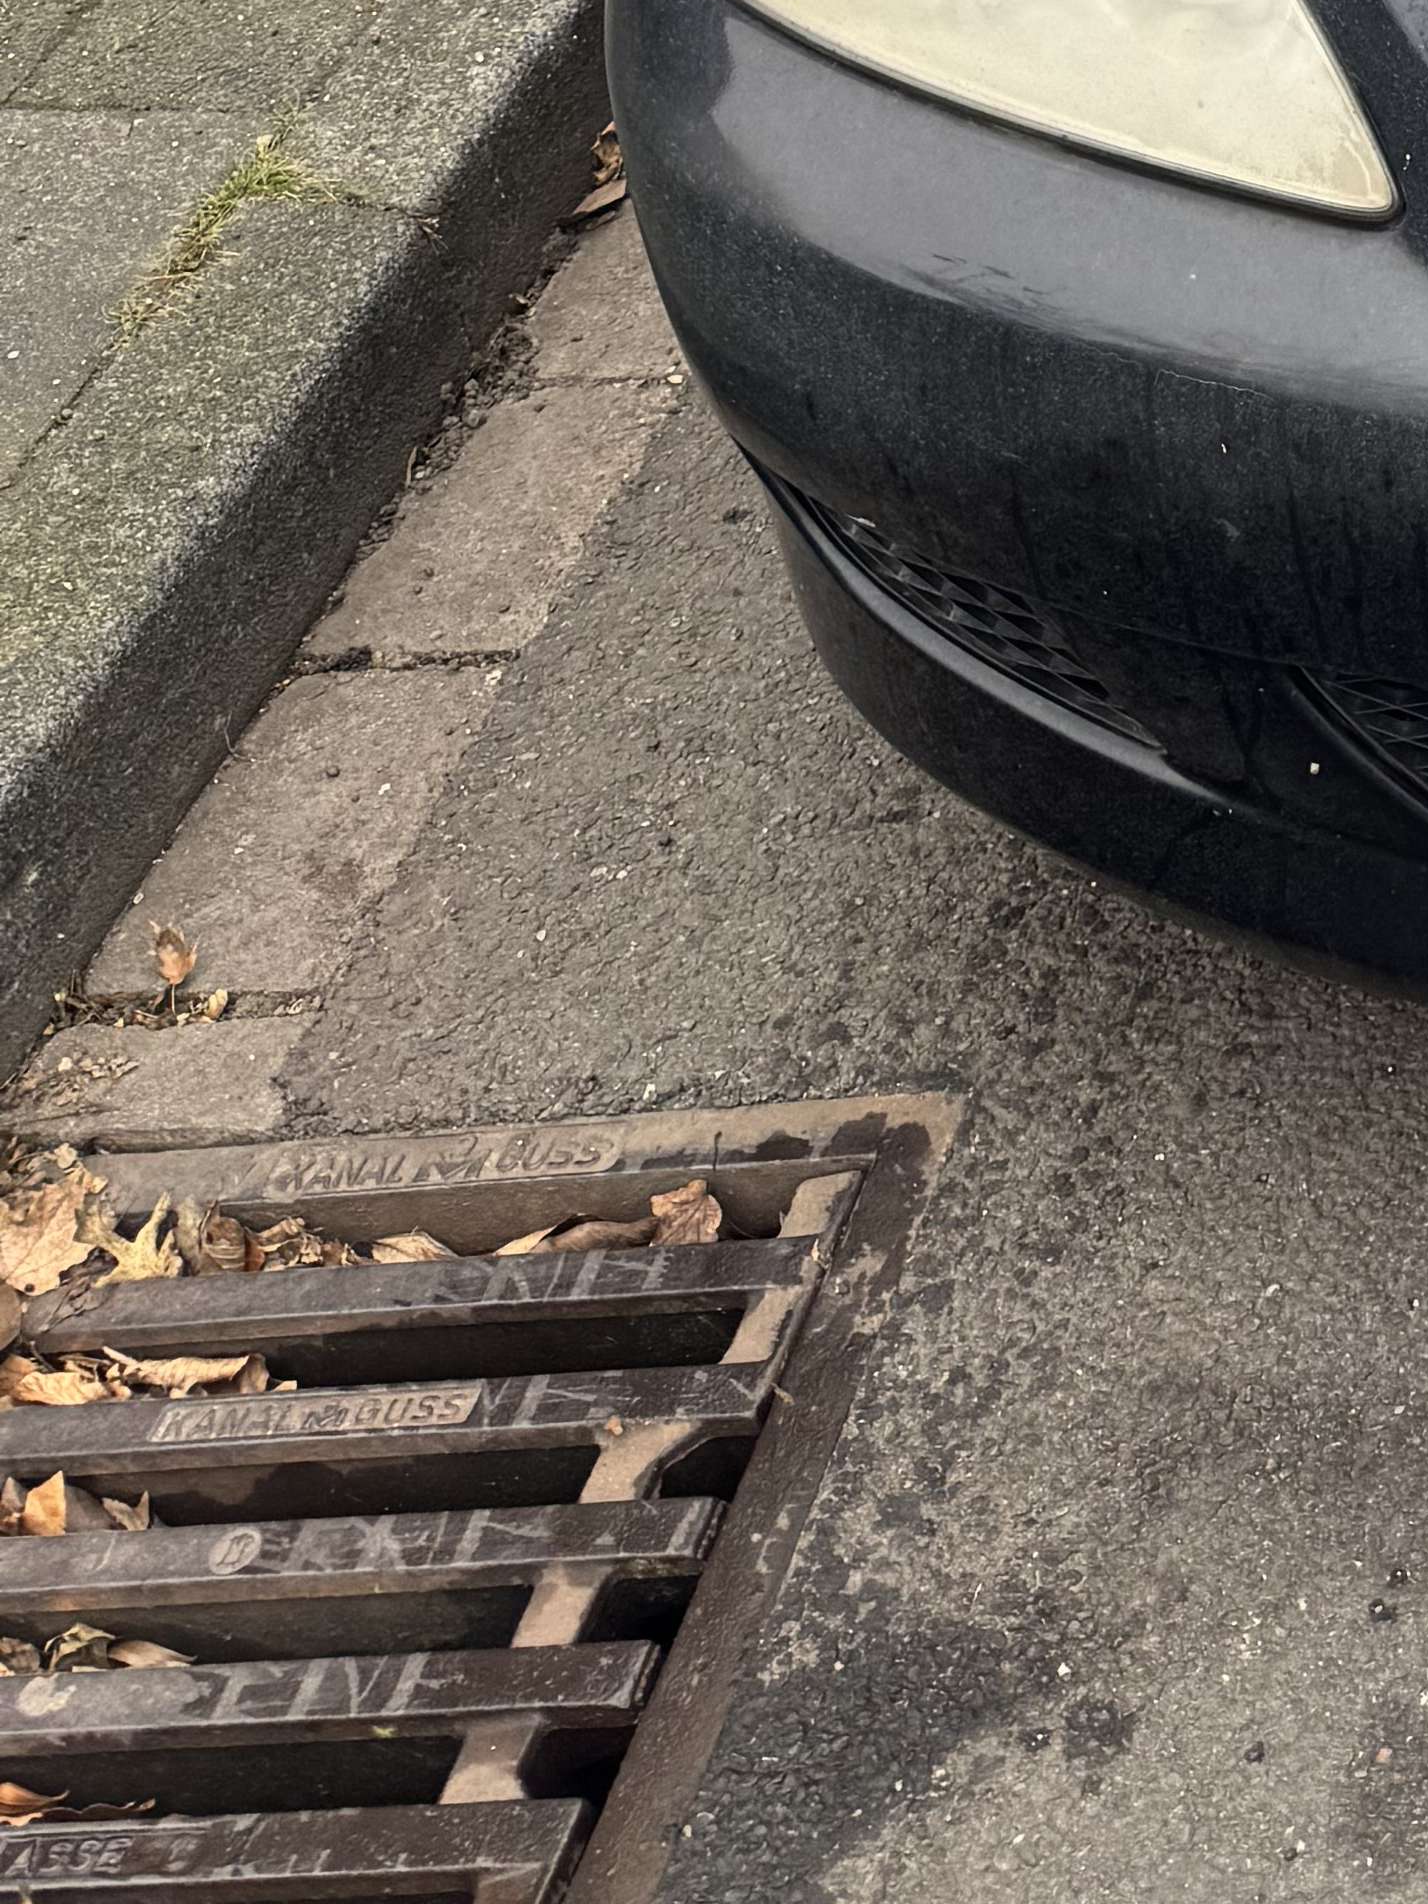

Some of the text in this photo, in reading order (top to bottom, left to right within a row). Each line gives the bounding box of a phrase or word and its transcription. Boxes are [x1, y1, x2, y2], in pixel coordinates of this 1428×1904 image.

[159, 1393, 468, 1441] KANAL GUSS
[0, 1837, 135, 1879] ASSE
